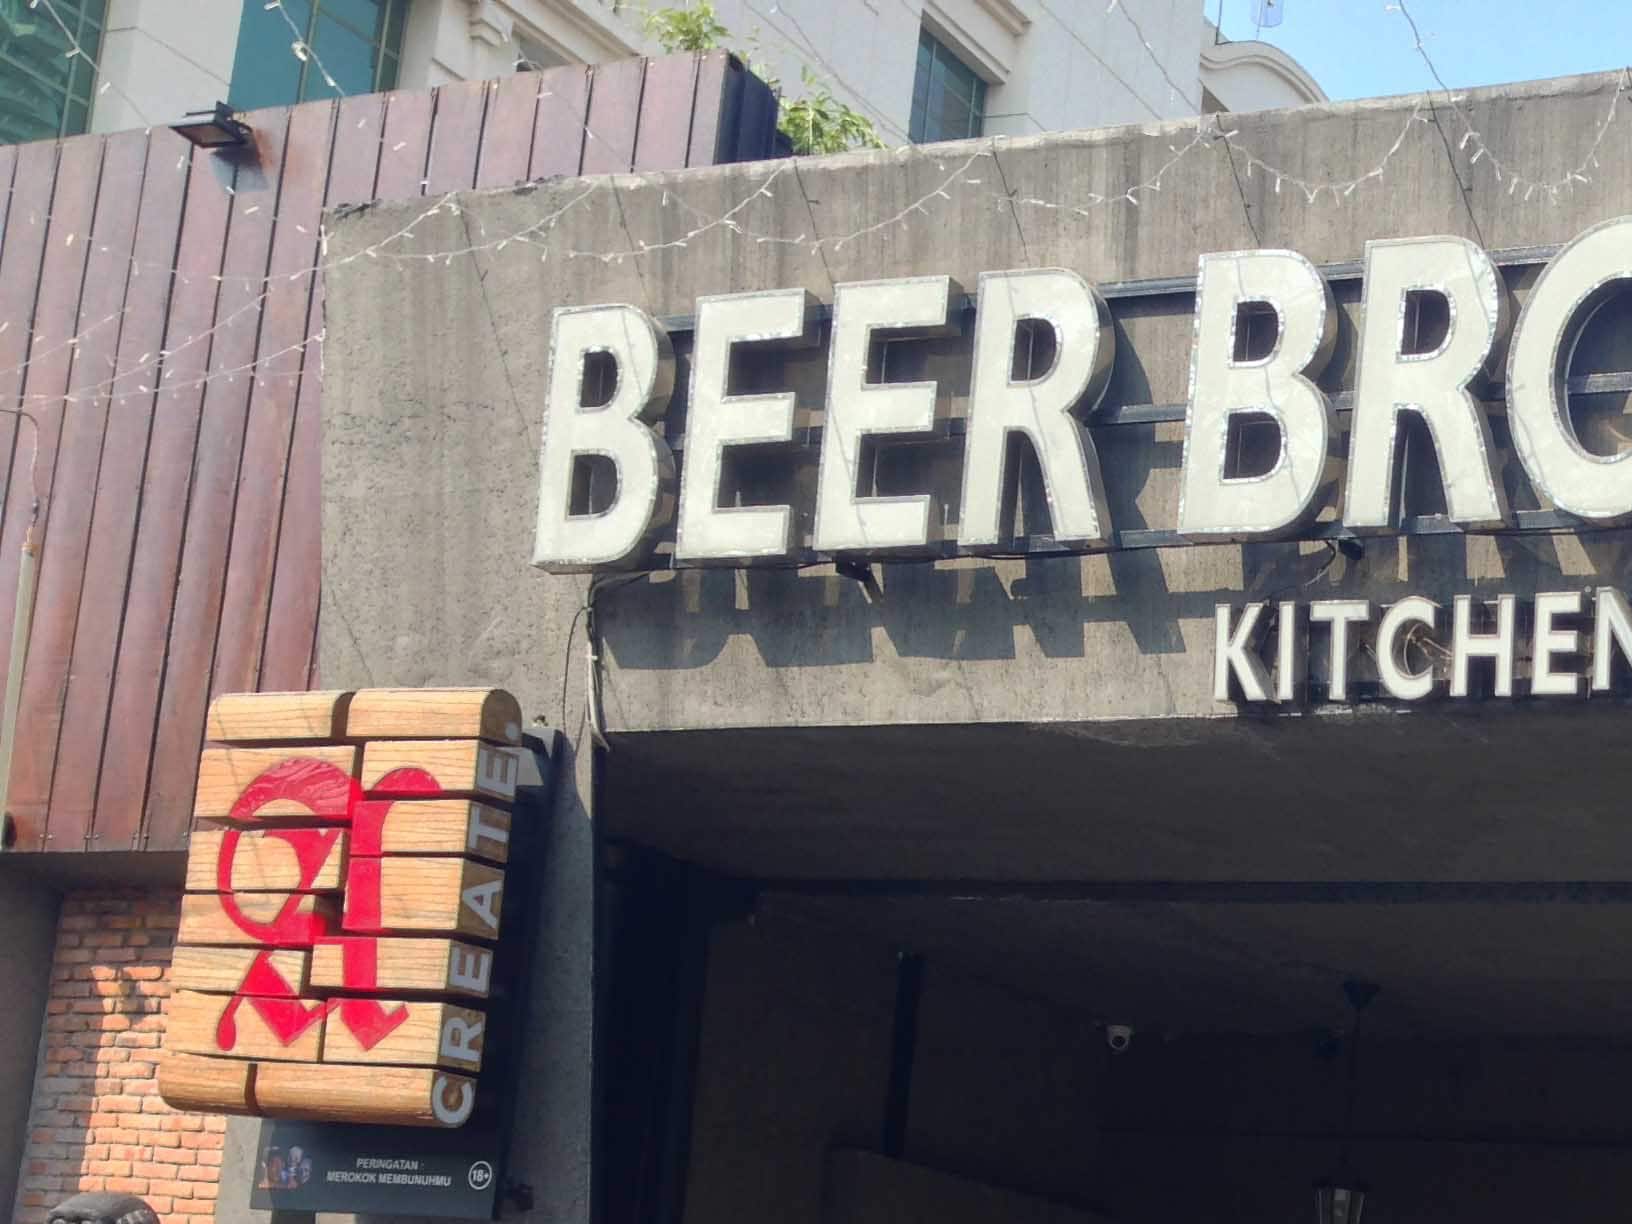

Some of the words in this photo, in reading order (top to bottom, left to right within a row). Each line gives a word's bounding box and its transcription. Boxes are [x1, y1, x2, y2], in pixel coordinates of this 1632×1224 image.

[533, 266, 1112, 572] BEER
[357, 1158, 418, 1171] PERINGATAN
[326, 1169, 377, 1183] MEROKOK
[378, 1171, 452, 1187] MEMBUNUHMU
